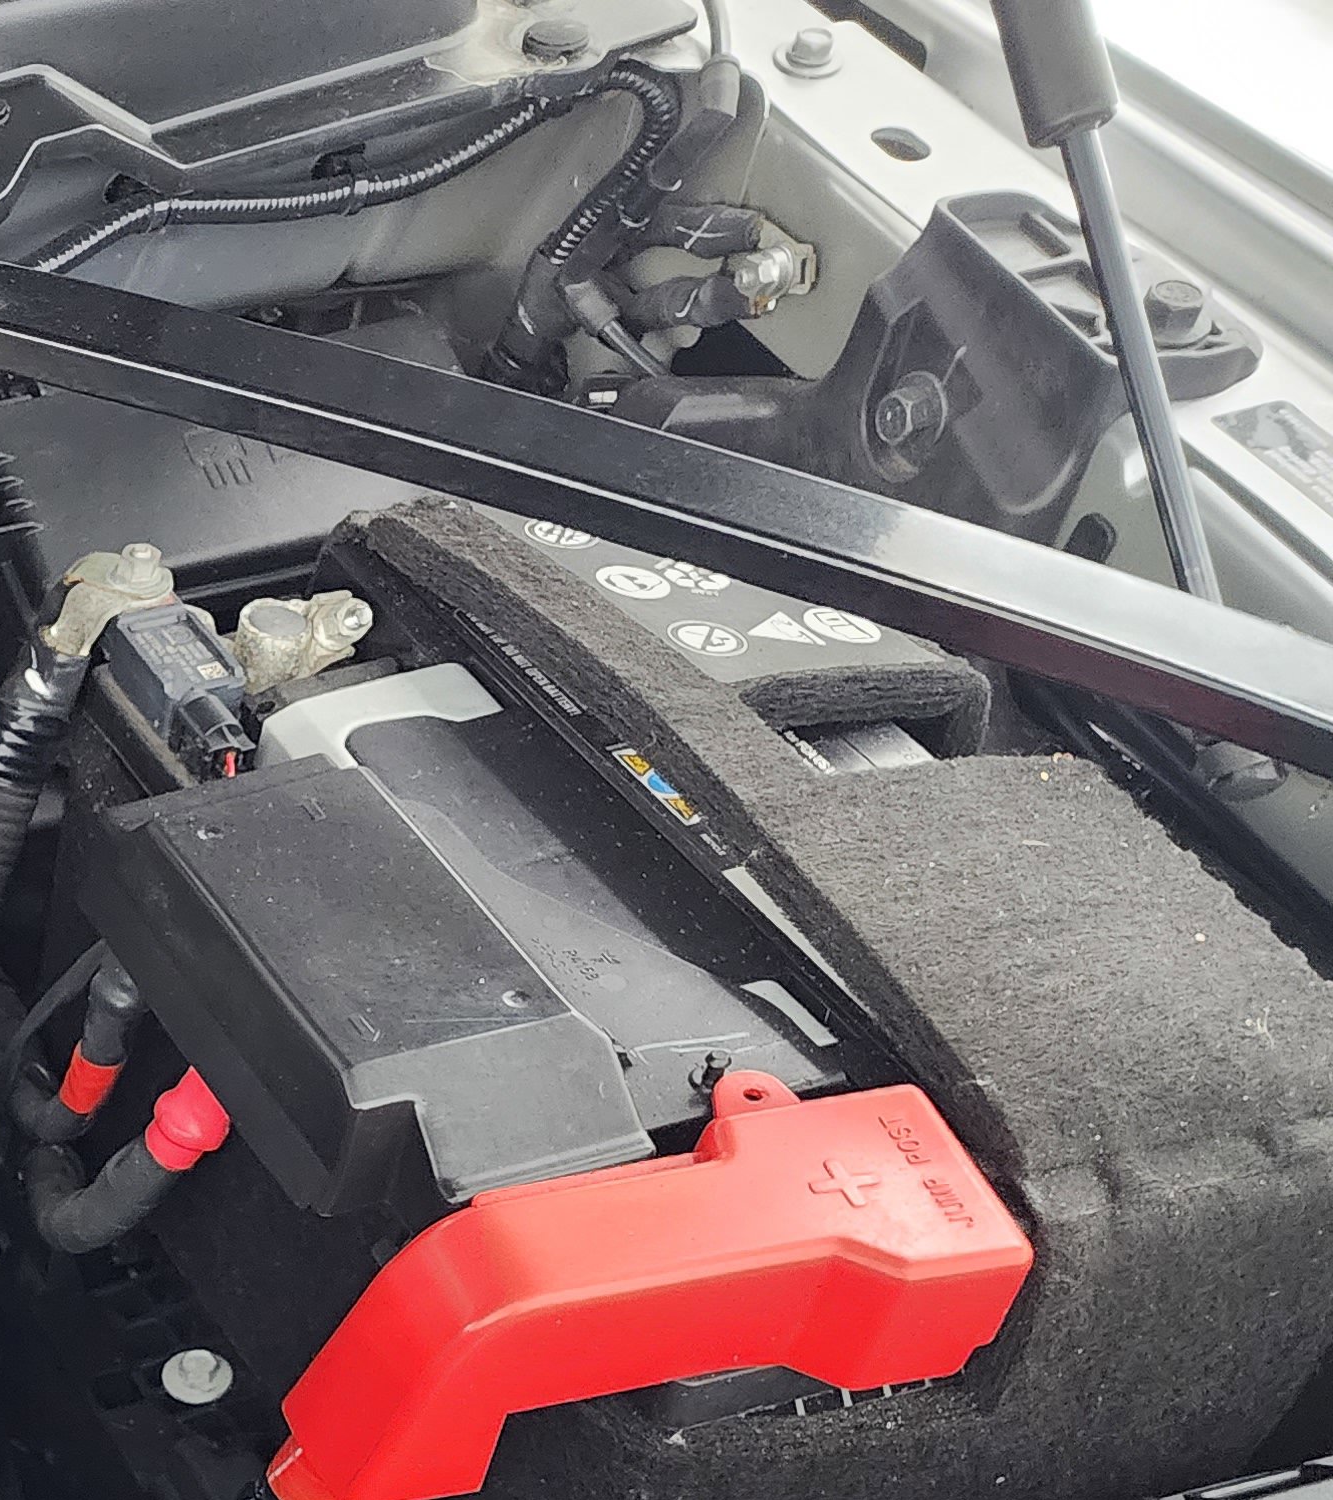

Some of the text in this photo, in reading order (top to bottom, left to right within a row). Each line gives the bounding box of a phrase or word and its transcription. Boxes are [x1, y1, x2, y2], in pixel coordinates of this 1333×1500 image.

[524, 668, 550, 685] OPEN
[878, 1114, 974, 1229] JUMP POST
